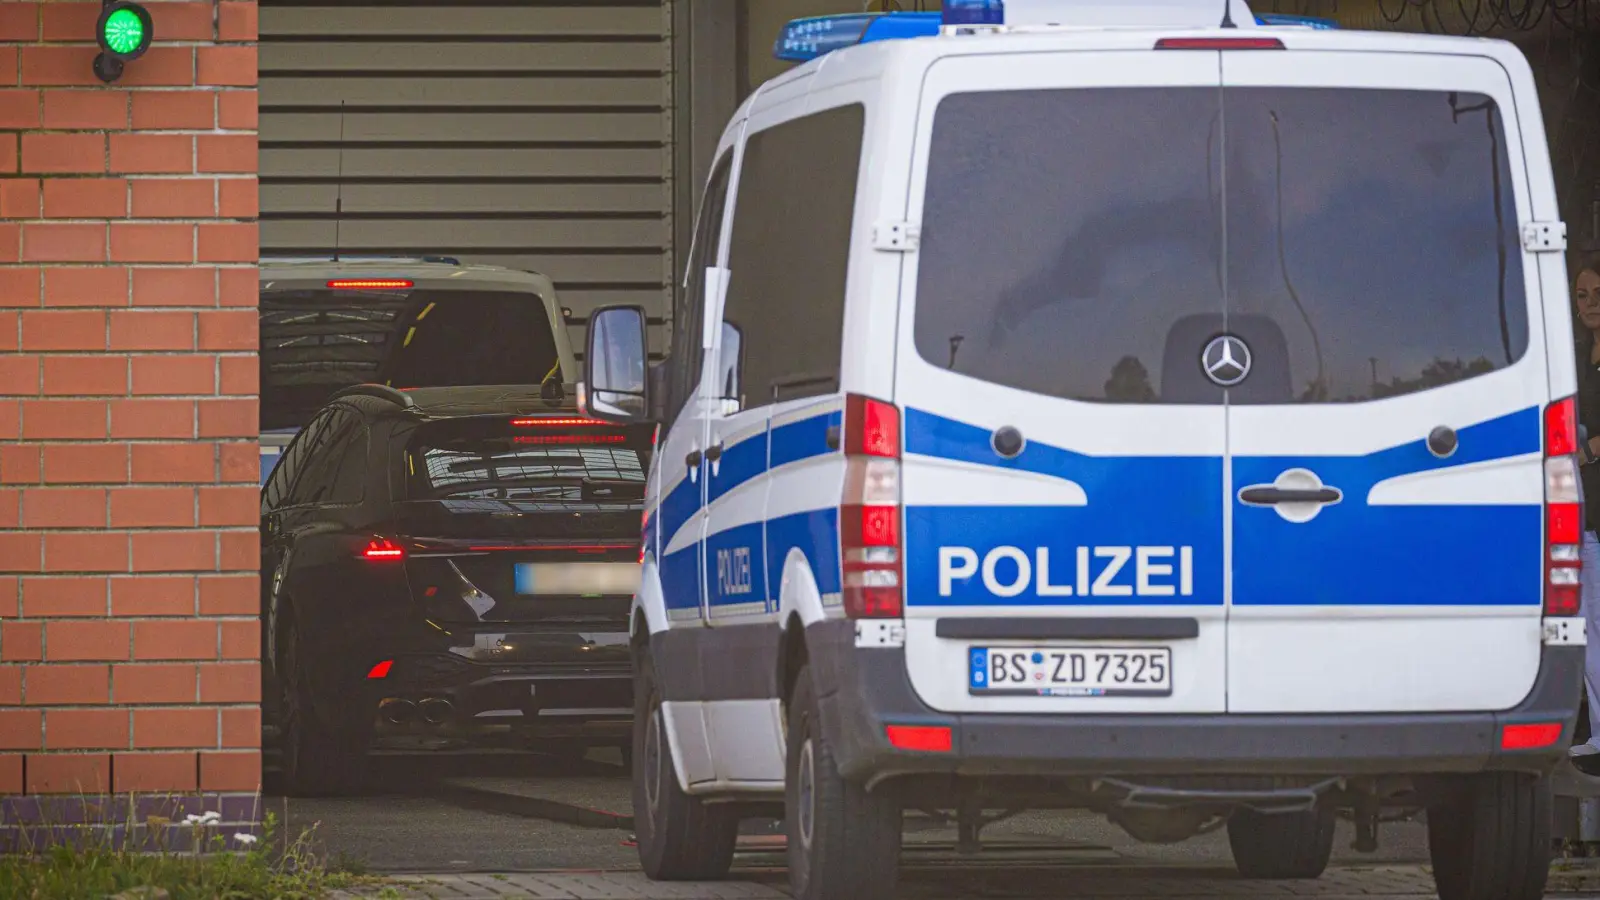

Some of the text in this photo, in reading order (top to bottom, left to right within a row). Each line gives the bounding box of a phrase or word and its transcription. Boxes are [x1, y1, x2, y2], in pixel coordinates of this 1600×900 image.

[717, 547, 752, 597] POLIZEI
[938, 545, 1194, 598] POLIZEI
[991, 653, 1165, 683] BS ZD 7325
